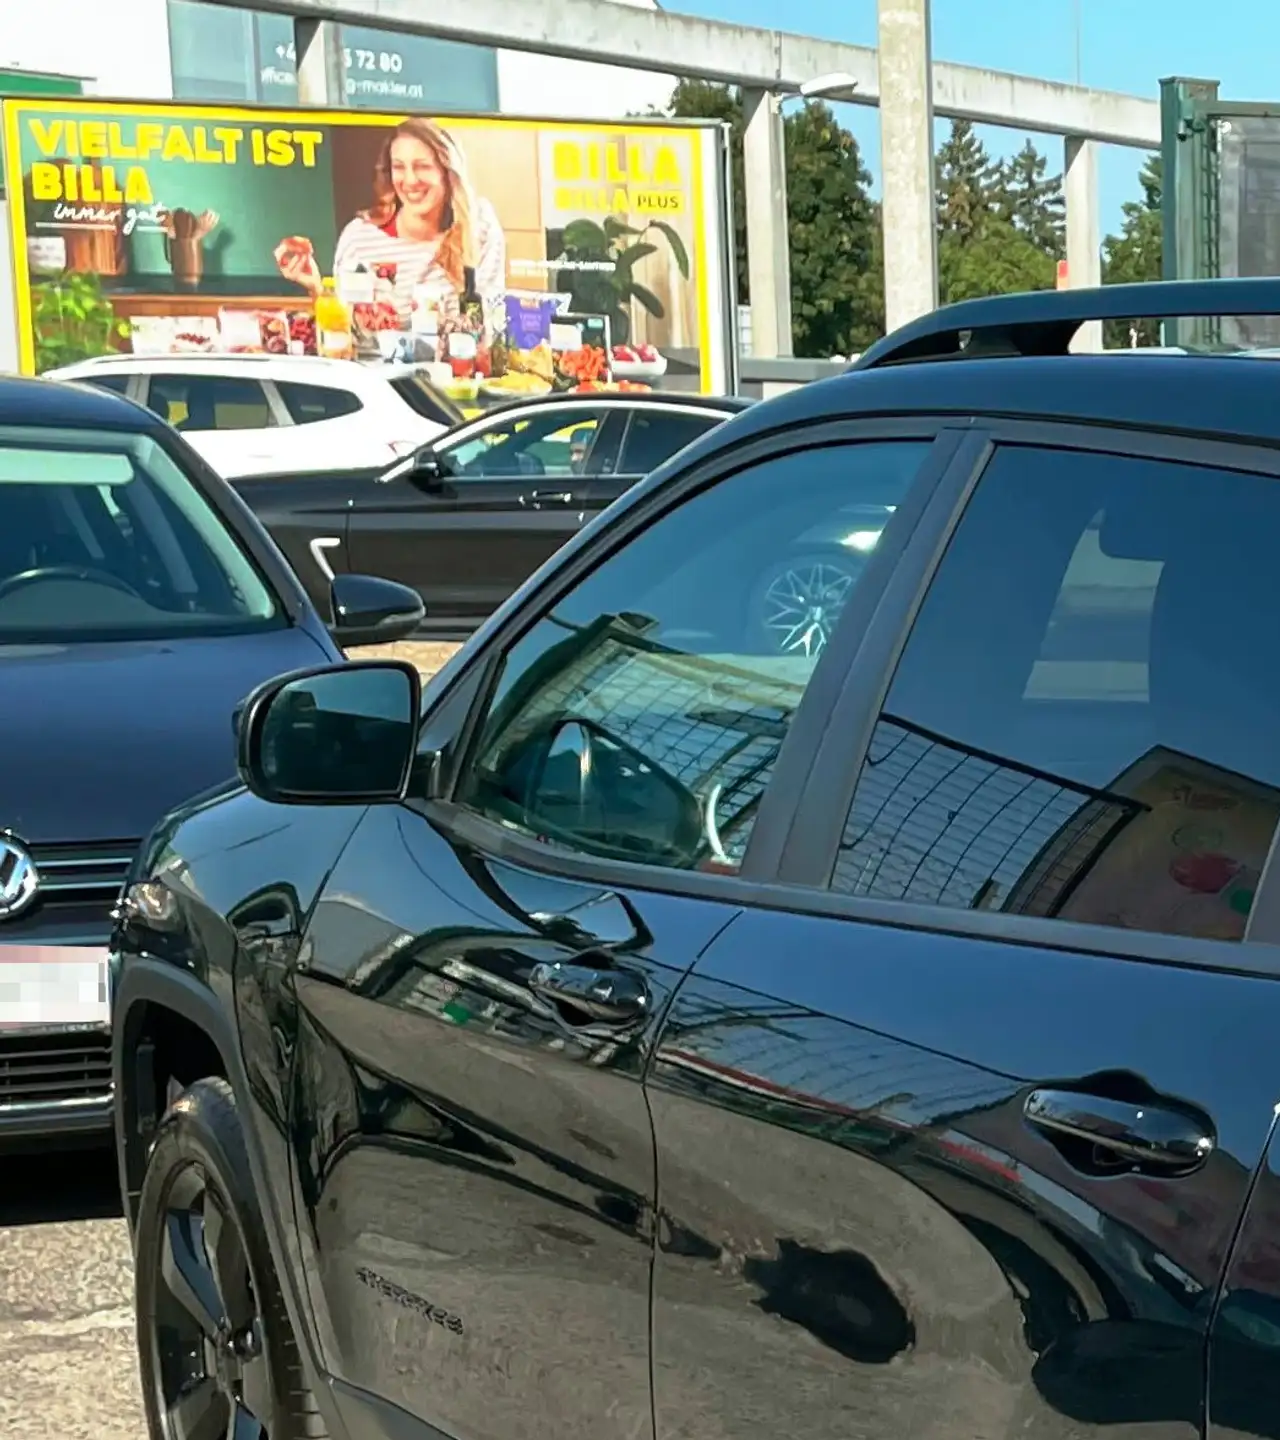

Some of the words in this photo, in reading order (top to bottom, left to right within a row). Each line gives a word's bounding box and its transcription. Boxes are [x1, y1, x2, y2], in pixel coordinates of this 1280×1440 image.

[355, 50, 376, 71] 72
[379, 52, 403, 75] 80
[28, 119, 243, 165] VIELFALT
[251, 128, 323, 167] IST
[553, 141, 681, 185] BILLA
[31, 162, 153, 205] BILLA
[637, 194, 679, 208] PLUS
